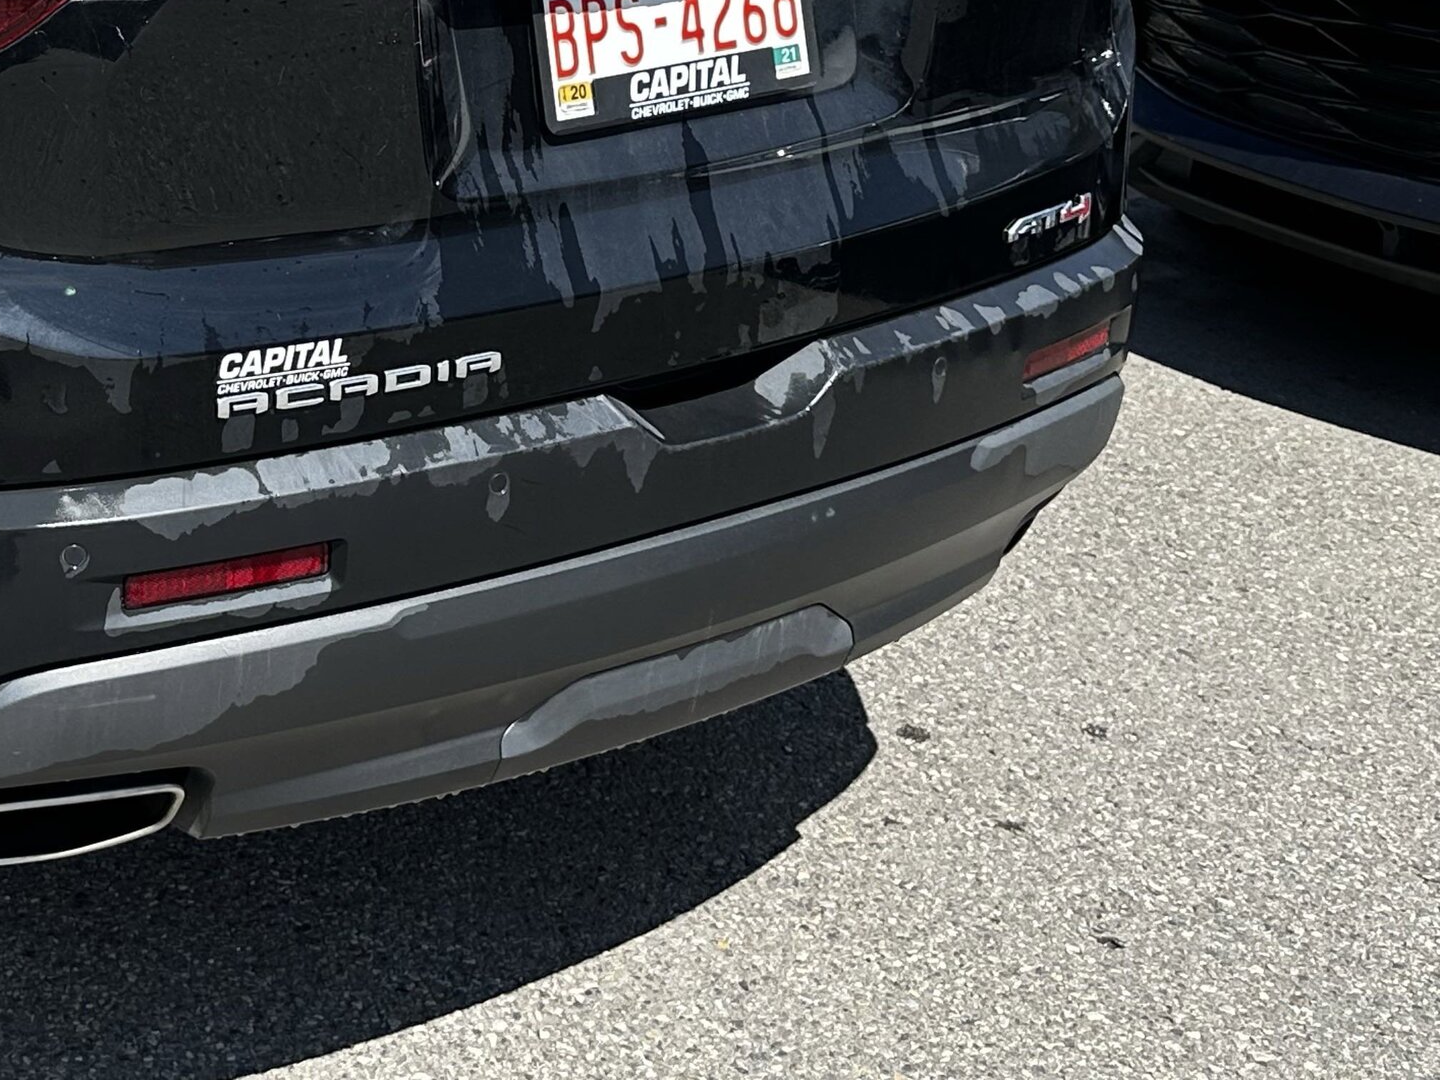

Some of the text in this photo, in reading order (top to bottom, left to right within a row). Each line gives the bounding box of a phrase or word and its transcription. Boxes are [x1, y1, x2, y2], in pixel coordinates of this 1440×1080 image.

[781, 47, 797, 63] 21
[570, 84, 587, 100] 20
[630, 55, 747, 102] CAPITAL
[219, 338, 348, 380] CAPITAL
[217, 351, 502, 419] ACADIA
